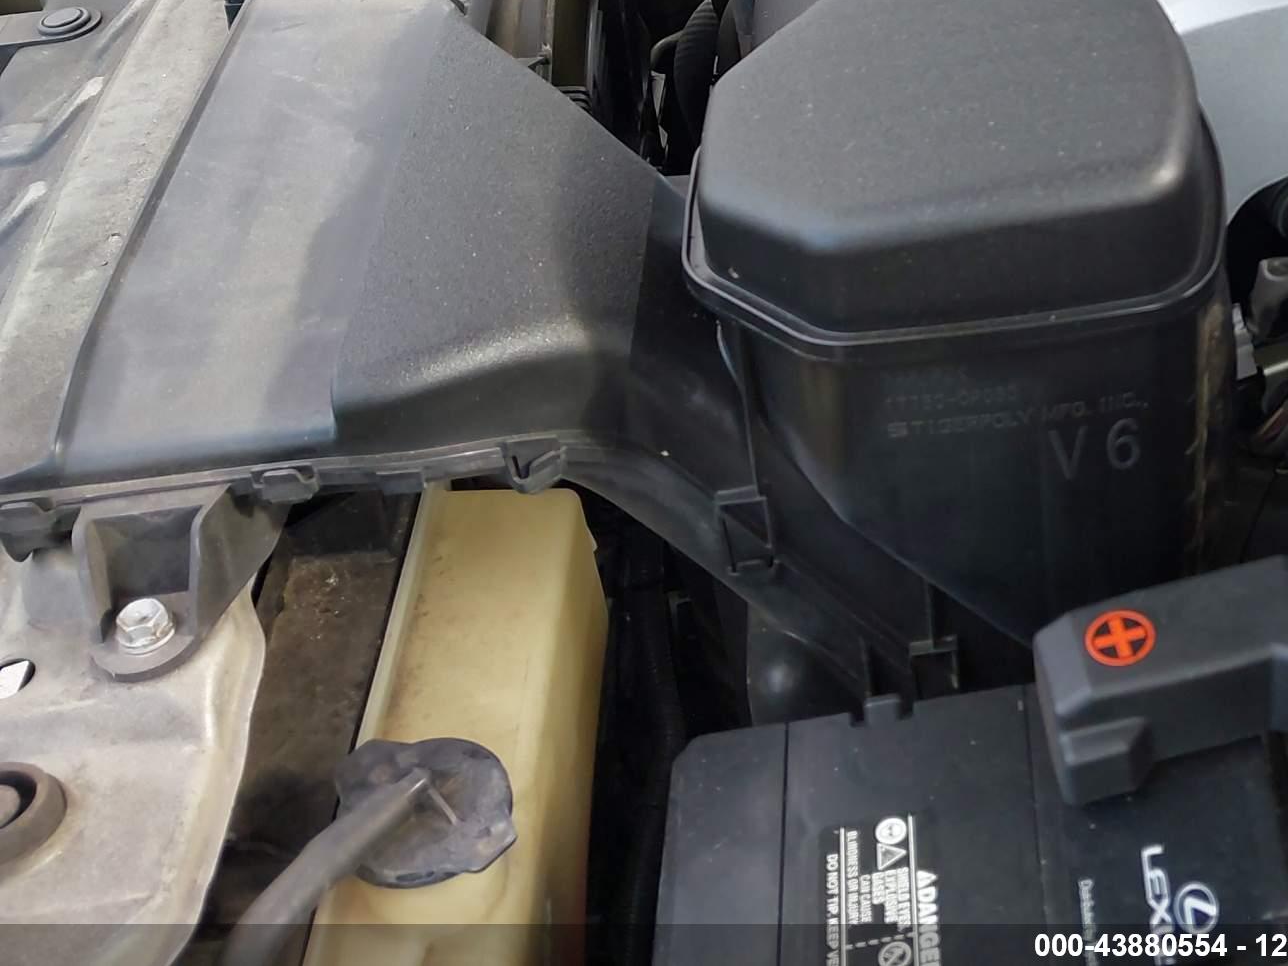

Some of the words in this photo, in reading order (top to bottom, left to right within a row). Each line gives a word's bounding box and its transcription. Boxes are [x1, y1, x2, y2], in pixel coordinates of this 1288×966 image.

[826, 853, 838, 870] DO
[847, 830, 859, 878] BLINDNESS
[826, 872, 838, 894] NOT
[848, 878, 859, 891] OR
[860, 874, 871, 894] CAN
[872, 872, 885, 905] GASES
[826, 895, 838, 917] TIP.
[885, 869, 898, 923] EXPLOSIVE
[860, 894, 872, 922] CAUSE
[826, 918, 839, 949] KEEP
[826, 950, 839, 966] VE
